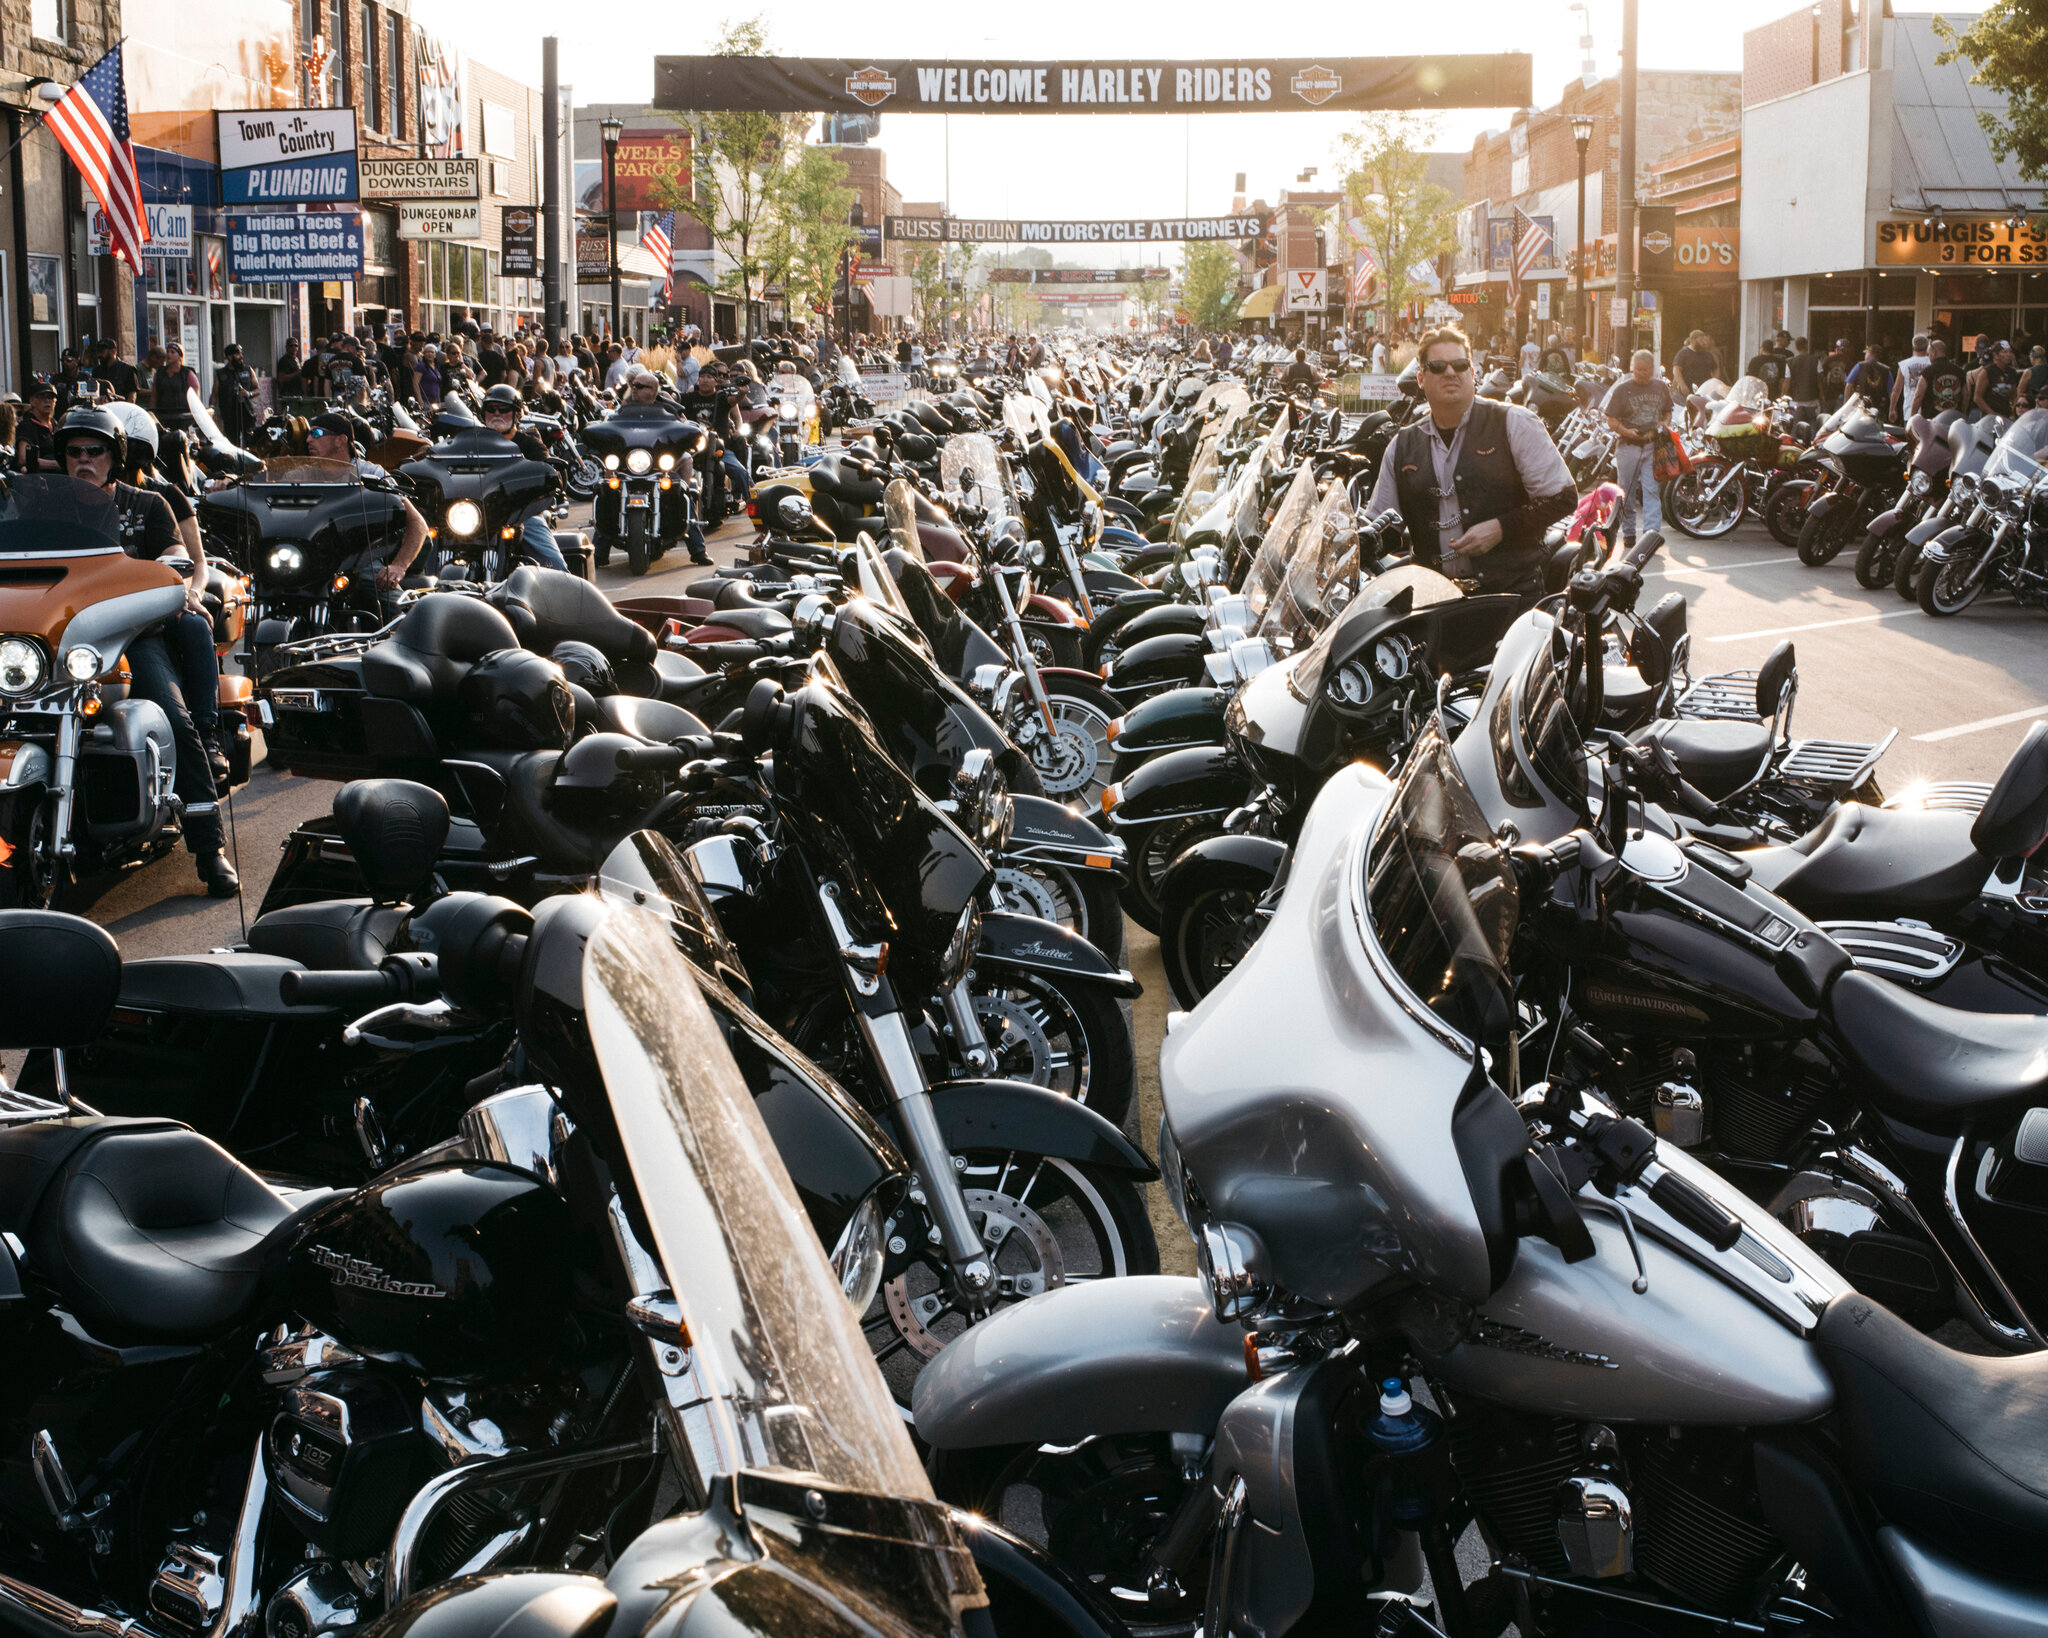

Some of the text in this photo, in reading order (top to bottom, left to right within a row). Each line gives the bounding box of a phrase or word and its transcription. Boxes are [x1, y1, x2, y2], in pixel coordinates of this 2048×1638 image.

[917, 67, 1272, 102] WELCOME HARLEY RIDERS
[238, 116, 308, 141] Town -n-
[279, 129, 335, 154] Country
[614, 146, 682, 160] WELLS
[361, 162, 475, 176] DUNGEON BAR
[614, 162, 682, 177] FARGO
[247, 167, 348, 197] PLUMBING
[368, 177, 469, 189] DOWNSTAIRS
[246, 215, 343, 231] Indian Tacos
[401, 208, 477, 220] DUNGEONBAR
[422, 222, 453, 233] OPEN
[893, 218, 1261, 240] RUSS BROWN MOTORCYCLE ATTORNEYS
[1880, 223, 1995, 243] STURGIS
[232, 232, 359, 253] Big Roast Beef &
[579, 240, 606, 252] RUSS
[1674, 236, 1733, 265] ob's
[234, 252, 359, 270] Pulled Pork Sandwiches
[1941, 245, 1955, 261] 3
[1964, 245, 2011, 262] FOR
[330, 1265, 448, 1298] Davidson
[303, 1443, 332, 1466] 107
